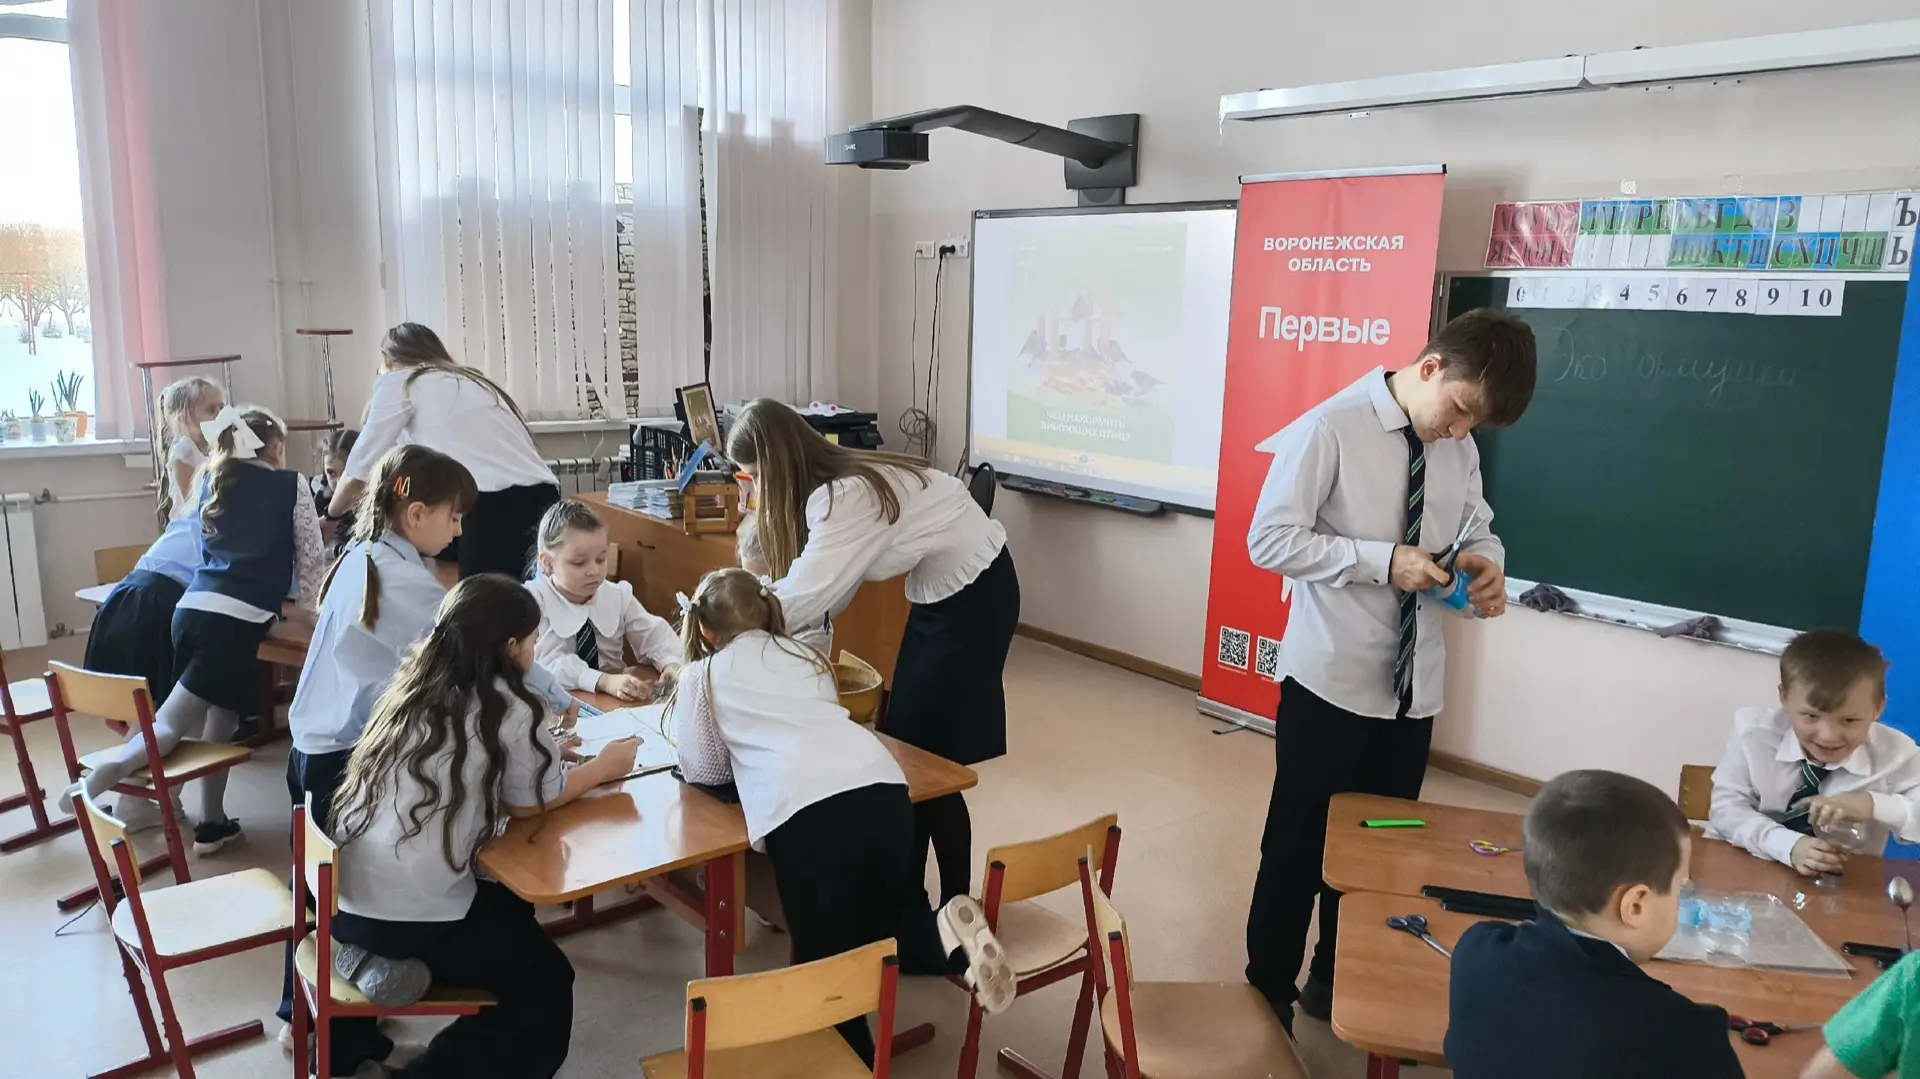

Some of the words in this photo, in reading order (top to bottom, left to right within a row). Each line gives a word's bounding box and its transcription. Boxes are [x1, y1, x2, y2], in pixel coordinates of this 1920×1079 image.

[1896, 197, 1917, 227] Ъ
[1263, 235, 1405, 251] ВОРОНЕЖСКАЯ
[1888, 236, 1909, 265] Ь
[1287, 258, 1372, 272] ОБЛАСТЬ
[1619, 284, 1630, 301] 4
[1648, 284, 1660, 301] 5
[1676, 287, 1688, 305] 6
[1705, 288, 1717, 306] 7
[1735, 288, 1747, 307] 8
[1767, 287, 1780, 306] 9
[1258, 306, 1391, 352] Первые
[1552, 328, 1607, 382] Эко
